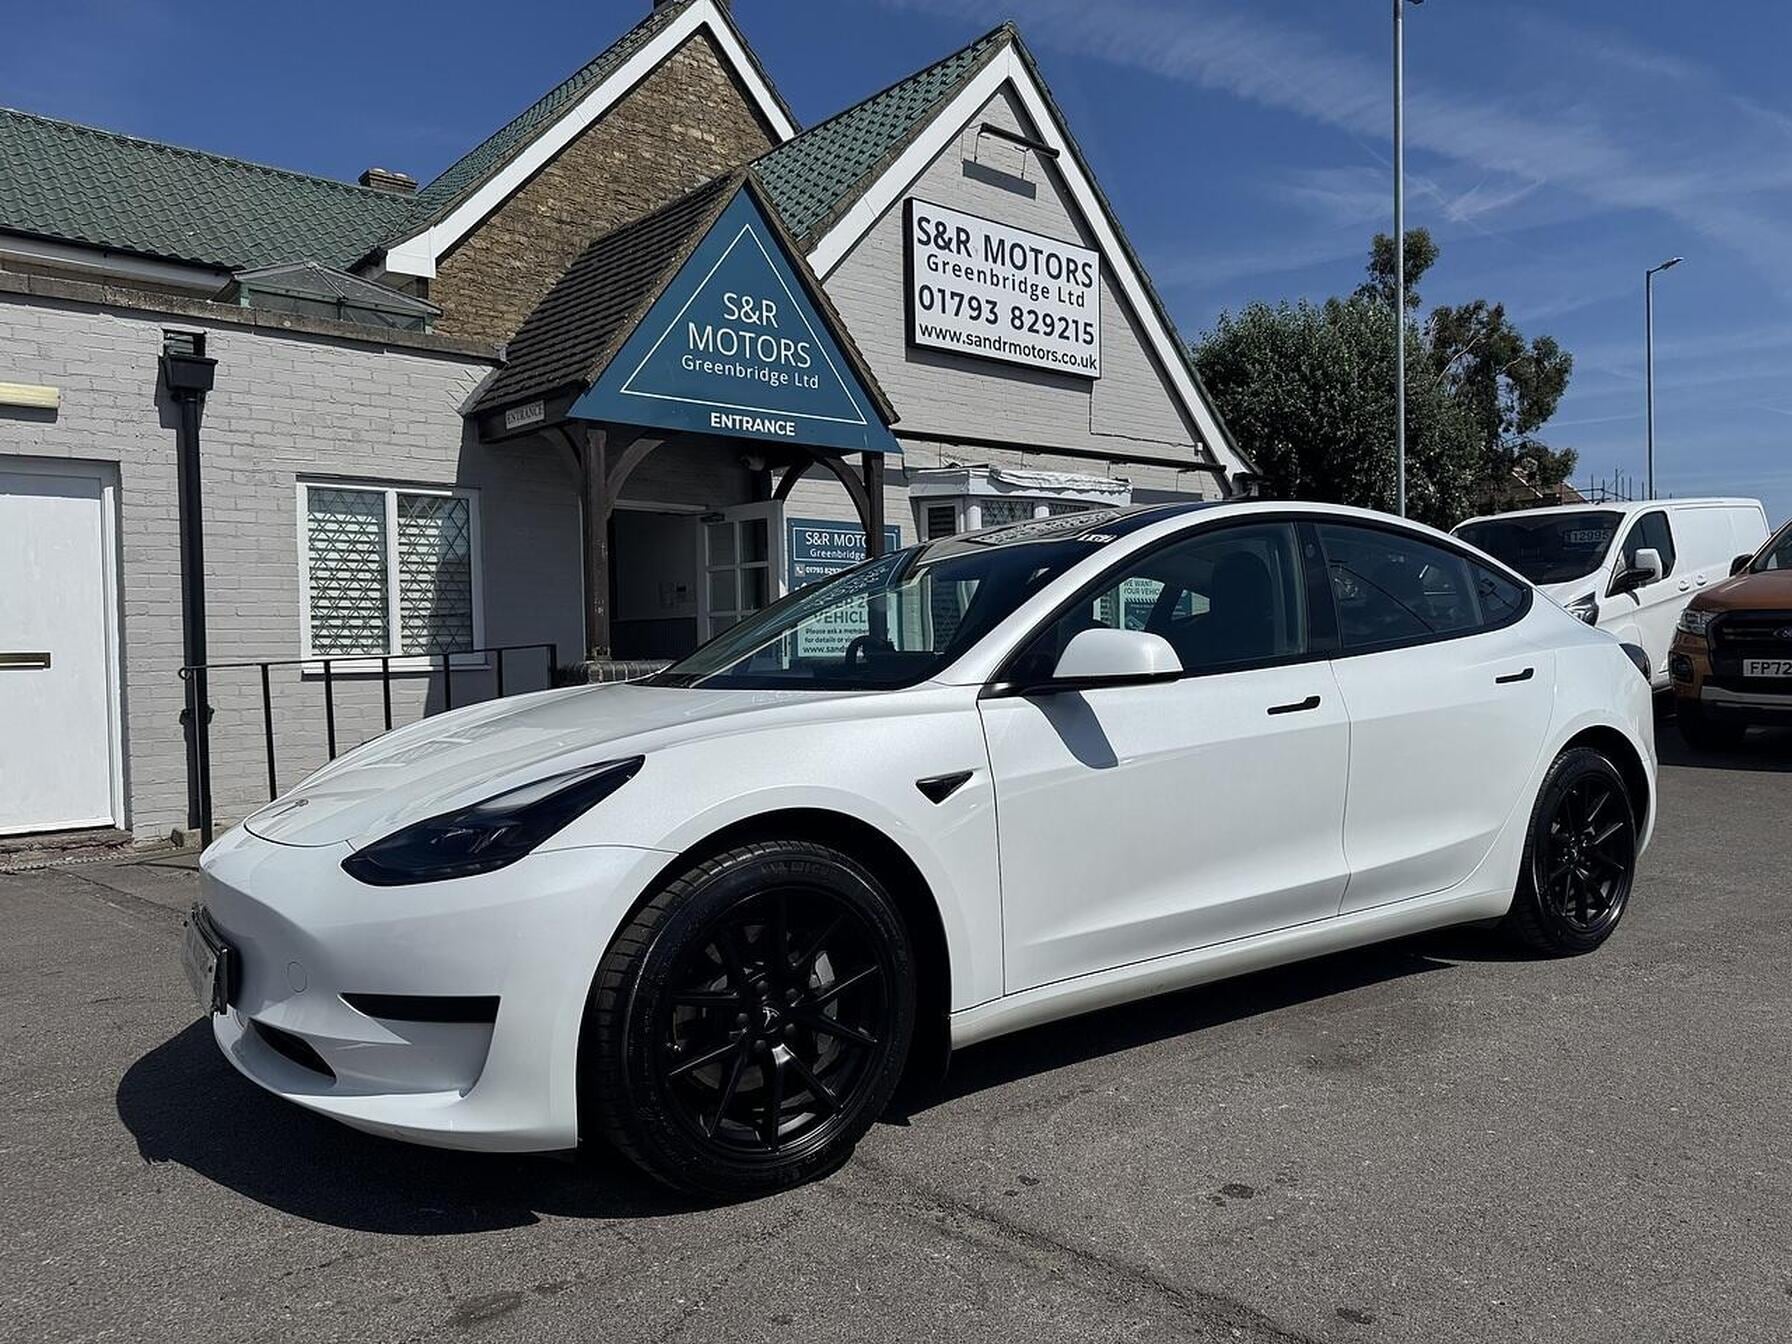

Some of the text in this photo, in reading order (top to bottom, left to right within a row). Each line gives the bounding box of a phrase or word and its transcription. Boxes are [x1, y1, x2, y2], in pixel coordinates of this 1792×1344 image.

[917, 216, 1093, 289] S&R MOTORS
[926, 253, 1085, 309] Greenbridge Ltd
[723, 292, 778, 329] S&R
[918, 284, 1095, 346] 01793 829215
[688, 321, 811, 368] MOTORS
[919, 323, 1098, 371] www.sandrmotors.co.uk
[681, 354, 819, 390] Greenbridge Ltd
[710, 412, 796, 436] ENTRANCE
[805, 531, 830, 546] S&R
[809, 548, 867, 561] Greenbridge
